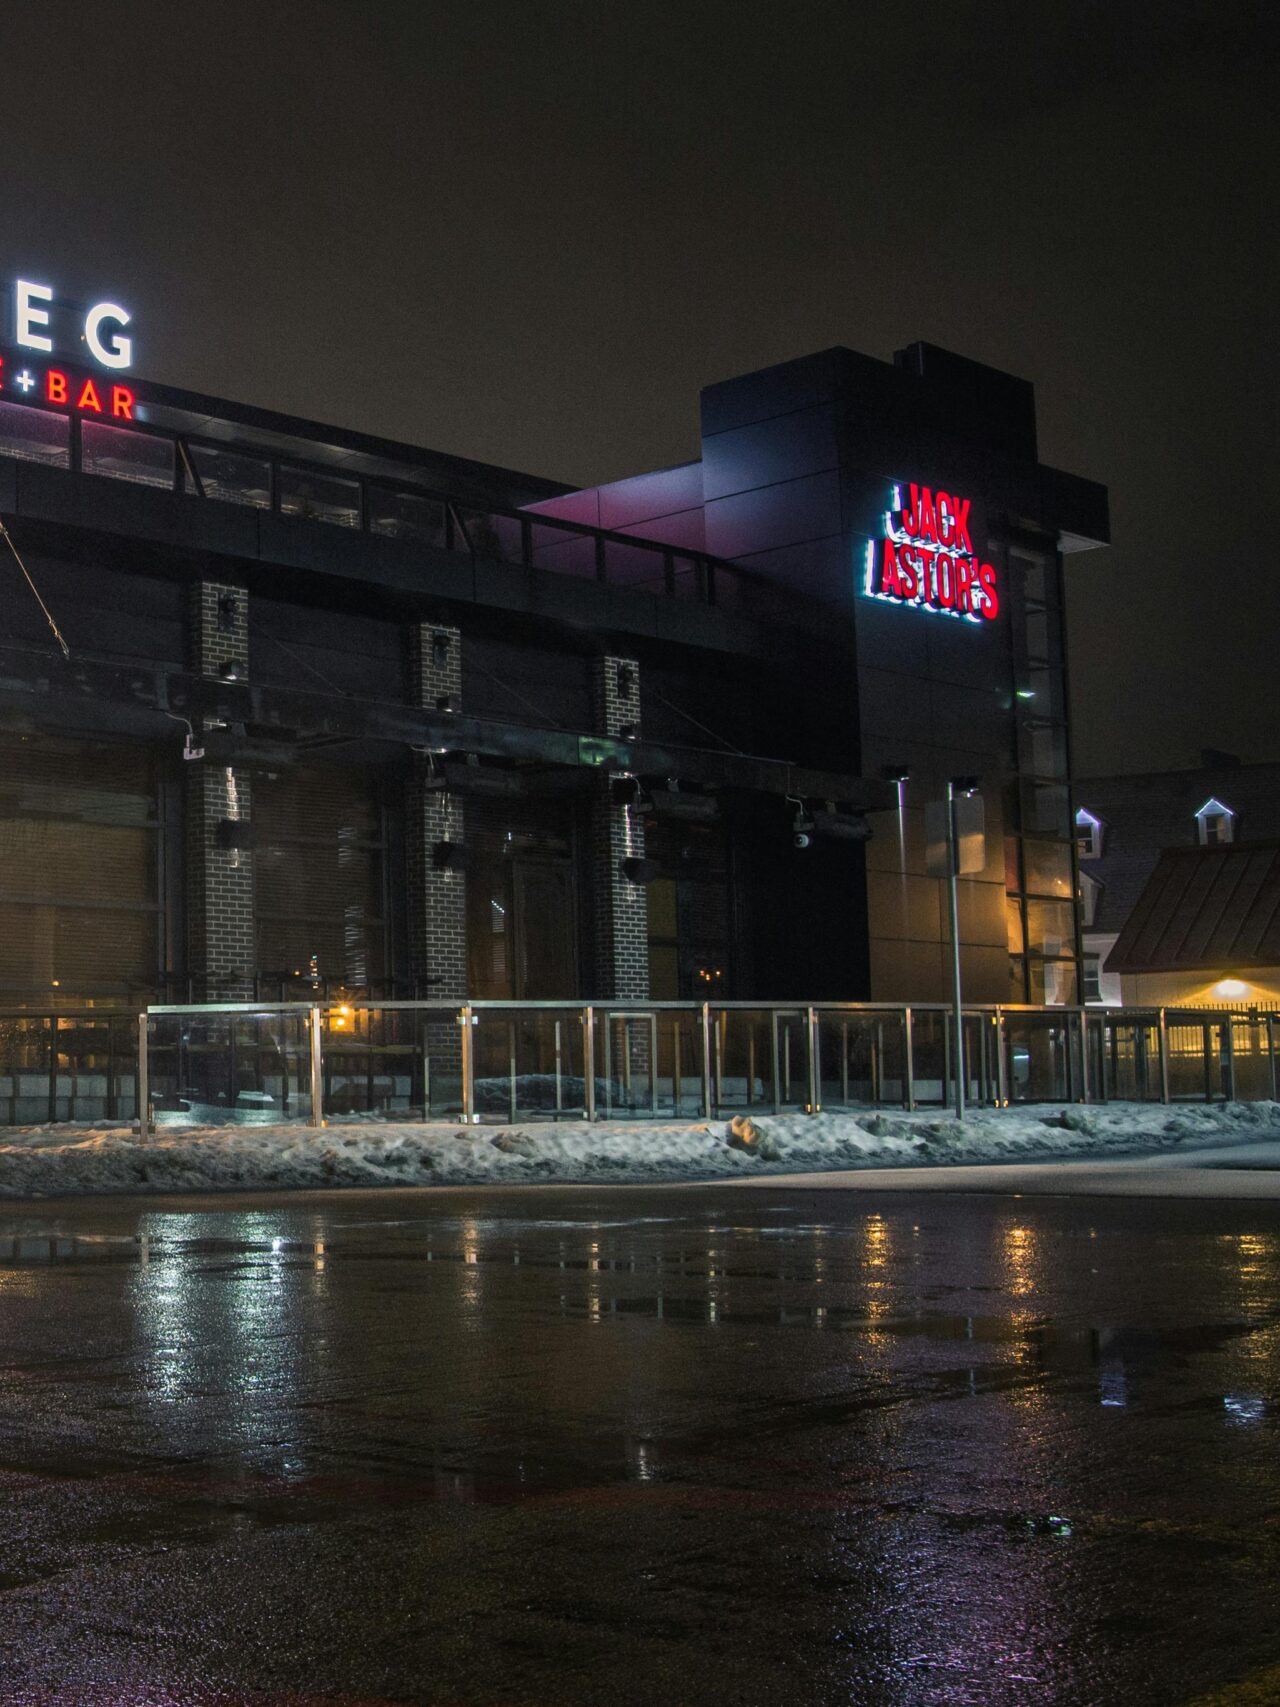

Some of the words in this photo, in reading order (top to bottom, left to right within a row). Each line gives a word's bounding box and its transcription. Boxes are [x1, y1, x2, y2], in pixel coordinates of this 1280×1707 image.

[48, 371, 135, 420] BAR
[902, 482, 973, 555] JACK
[882, 537, 999, 620] ASTOR'S
